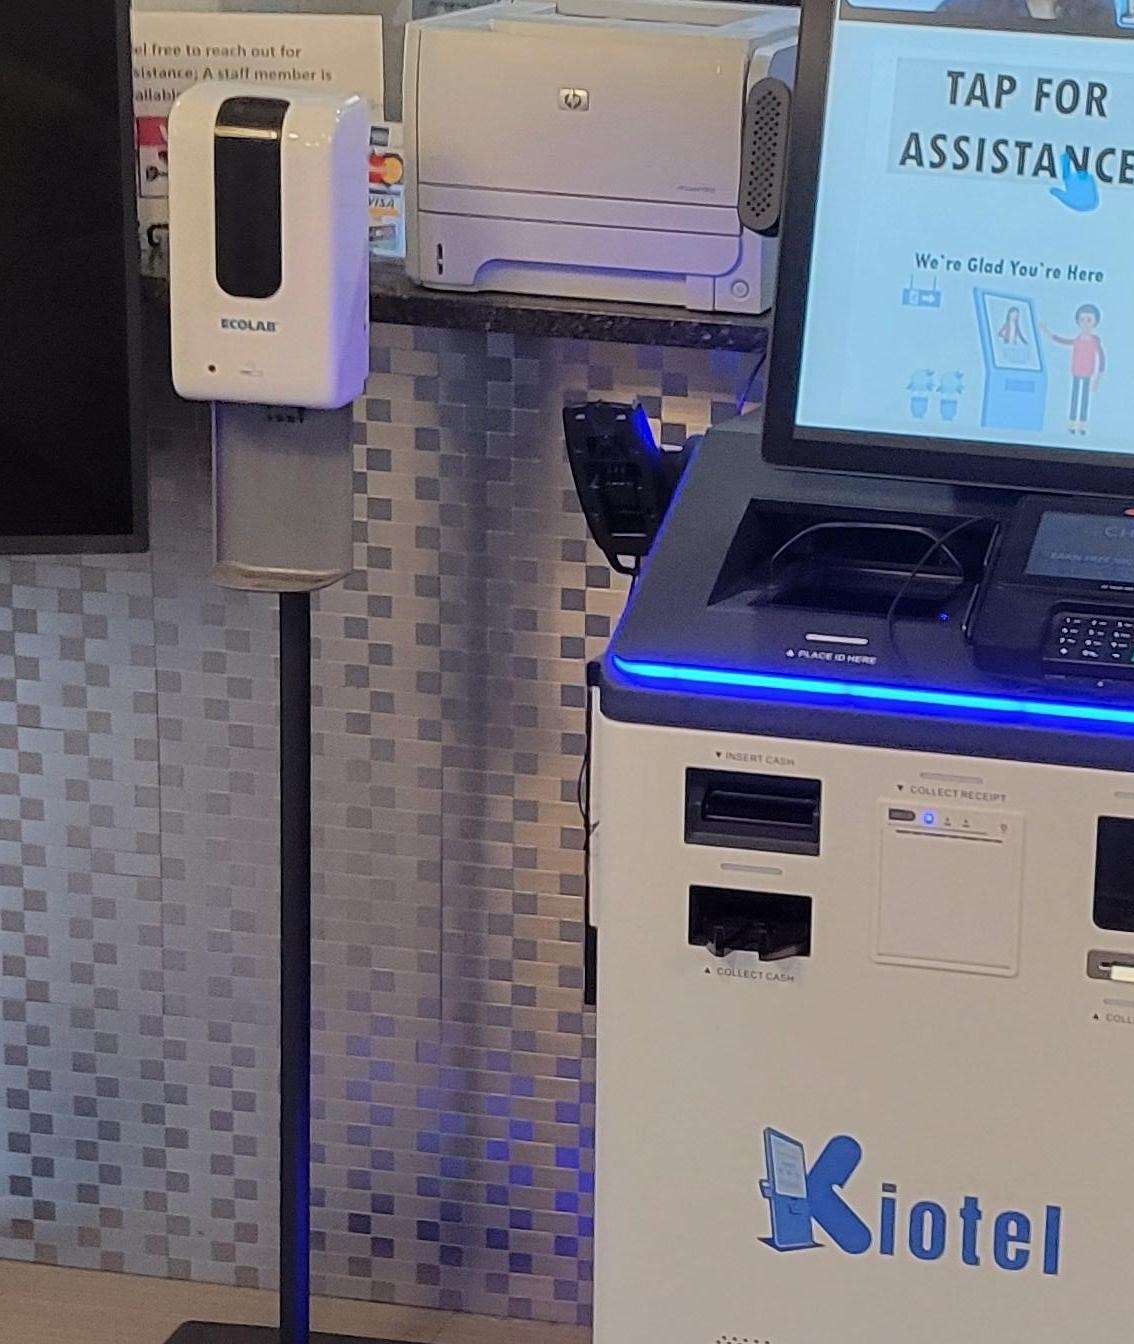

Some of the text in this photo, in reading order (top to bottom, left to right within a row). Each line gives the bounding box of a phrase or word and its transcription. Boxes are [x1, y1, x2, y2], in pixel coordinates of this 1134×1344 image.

[151, 43, 182, 56] free
[186, 44, 201, 56] to
[205, 44, 247, 57] reach
[250, 46, 275, 58] out
[280, 44, 303, 59] for
[202, 67, 214, 81] A
[217, 67, 250, 82] staff
[254, 69, 317, 82] member
[321, 68, 333, 82] is
[946, 70, 1109, 118] TAP FOR
[915, 252, 1105, 283] We're Glad You're Here
[220, 318, 276, 332] ECOLAB
[798, 649, 878, 666] PLACE ID HERE
[725, 751, 795, 766] INSERT CASH
[910, 784, 1007, 802] COLLECT RECEIPT
[716, 966, 795, 983] COLLECT CASH
[757, 1126, 1062, 1276] Kiotel
